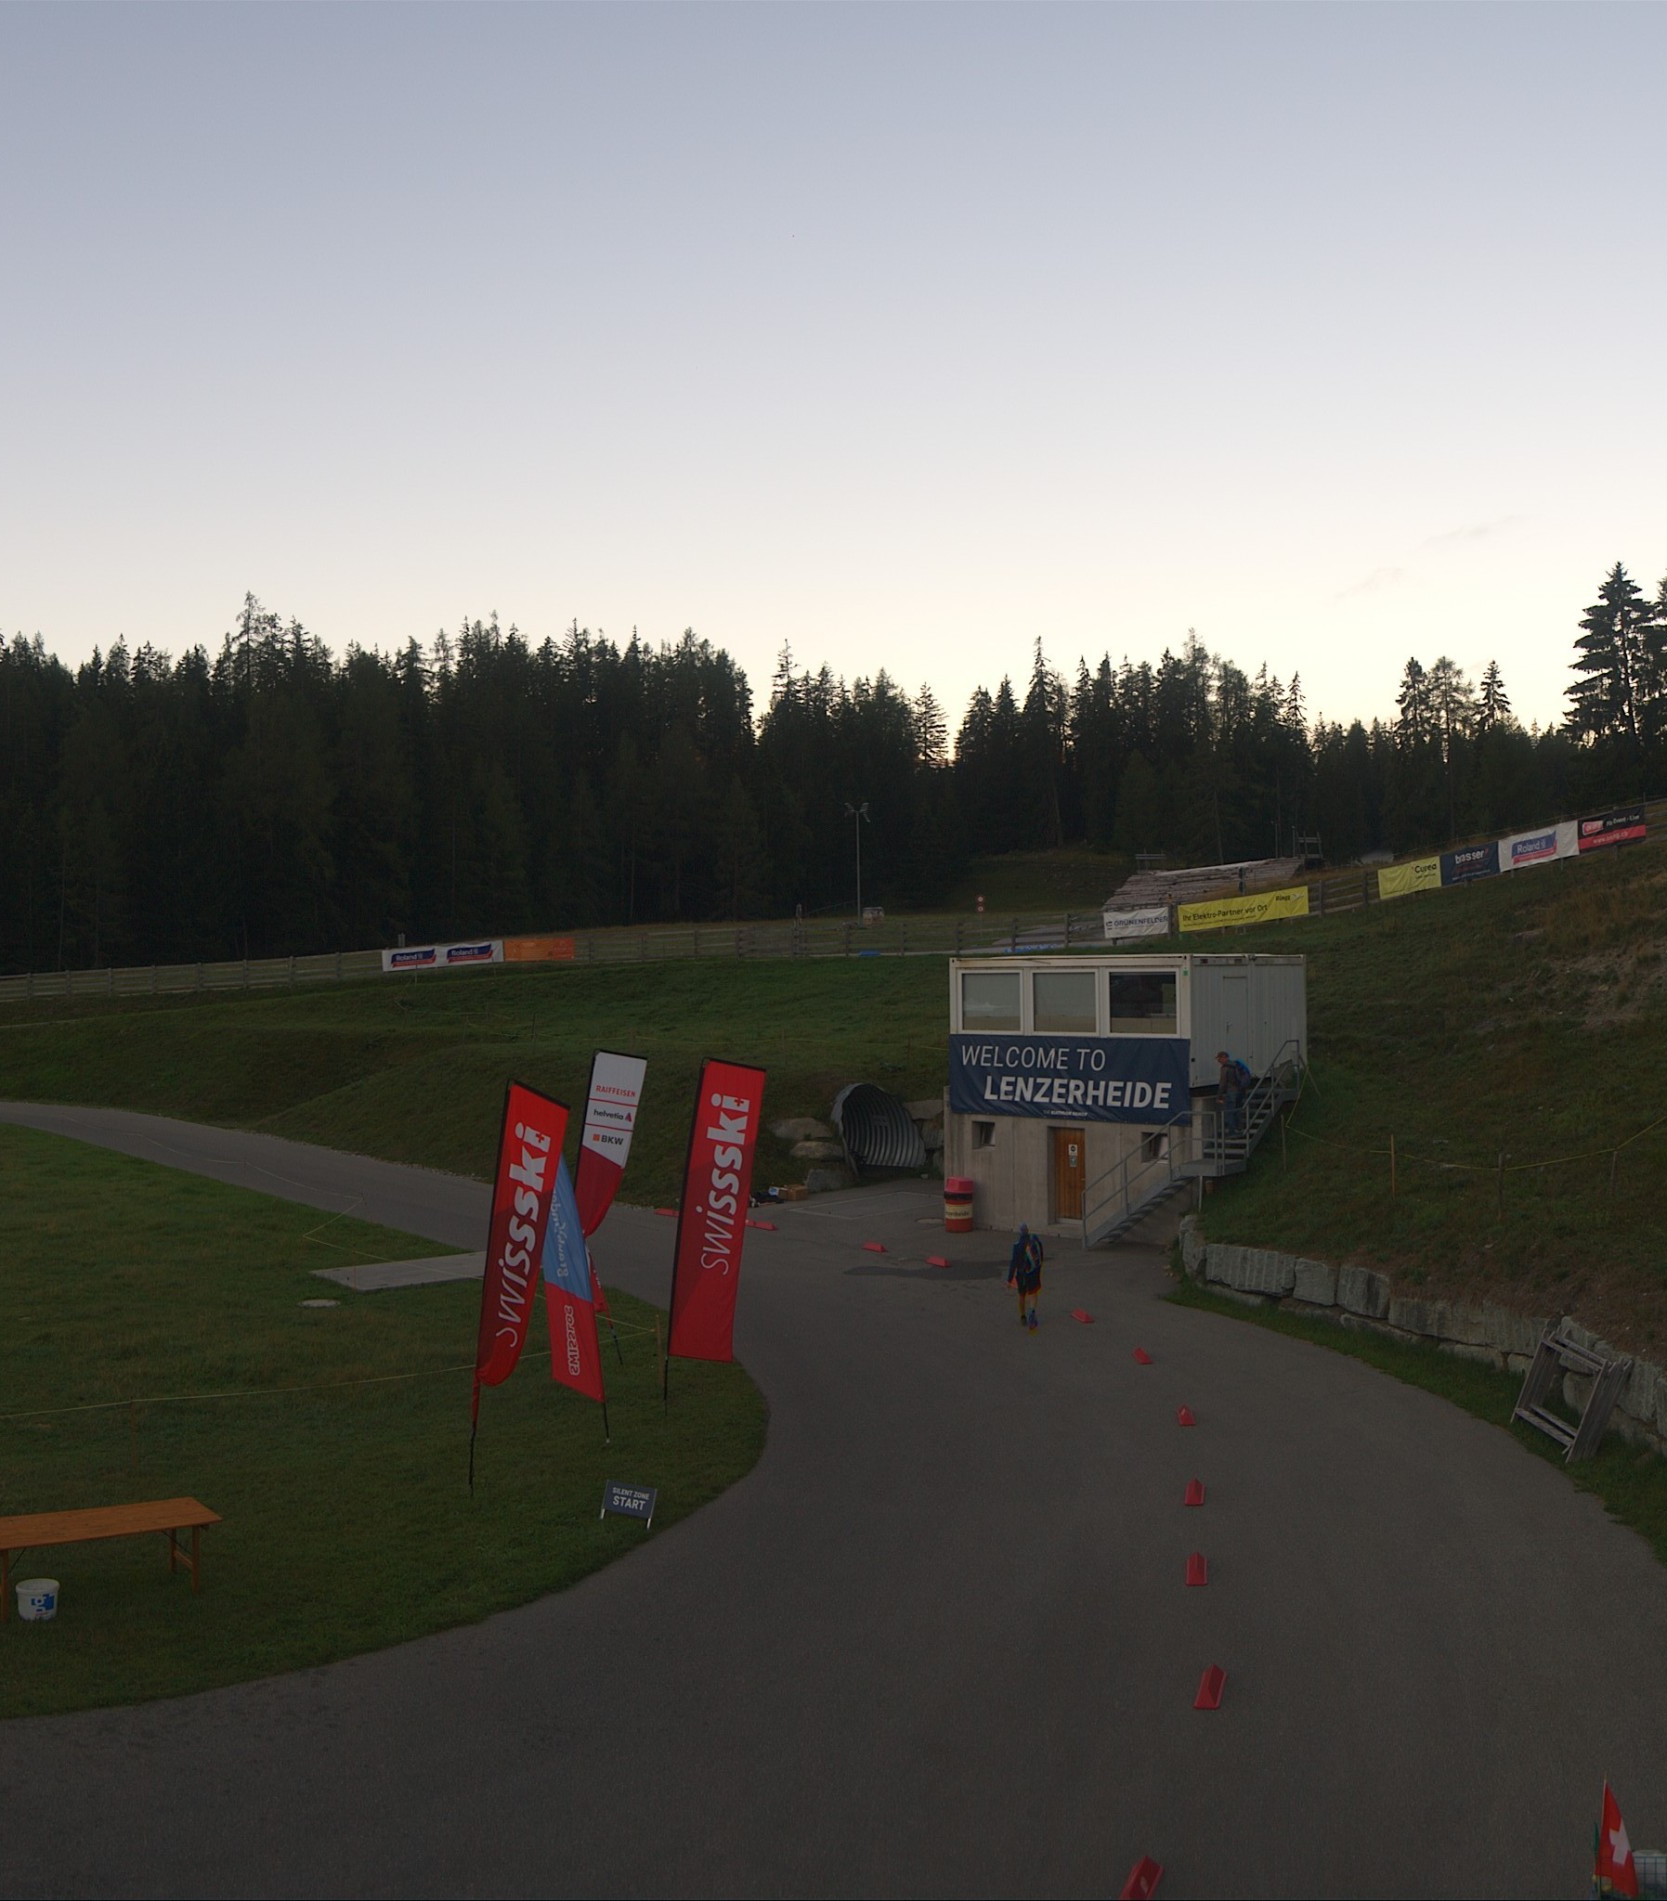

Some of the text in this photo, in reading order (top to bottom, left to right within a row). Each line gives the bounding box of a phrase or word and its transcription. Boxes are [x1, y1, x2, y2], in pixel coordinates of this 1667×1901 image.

[1517, 841, 1540, 854] Roland
[961, 1045, 1106, 1071] WELCOME TO
[596, 1085, 636, 1097] RAIFFEISEN
[984, 1075, 1172, 1110] LENZERHEIDE
[594, 1109, 624, 1120] helvetia
[601, 1135, 624, 1145] BKW
[701, 1092, 750, 1275] swissski
[612, 1487, 650, 1500] SILENT ZONE
[613, 1495, 646, 1511] START
